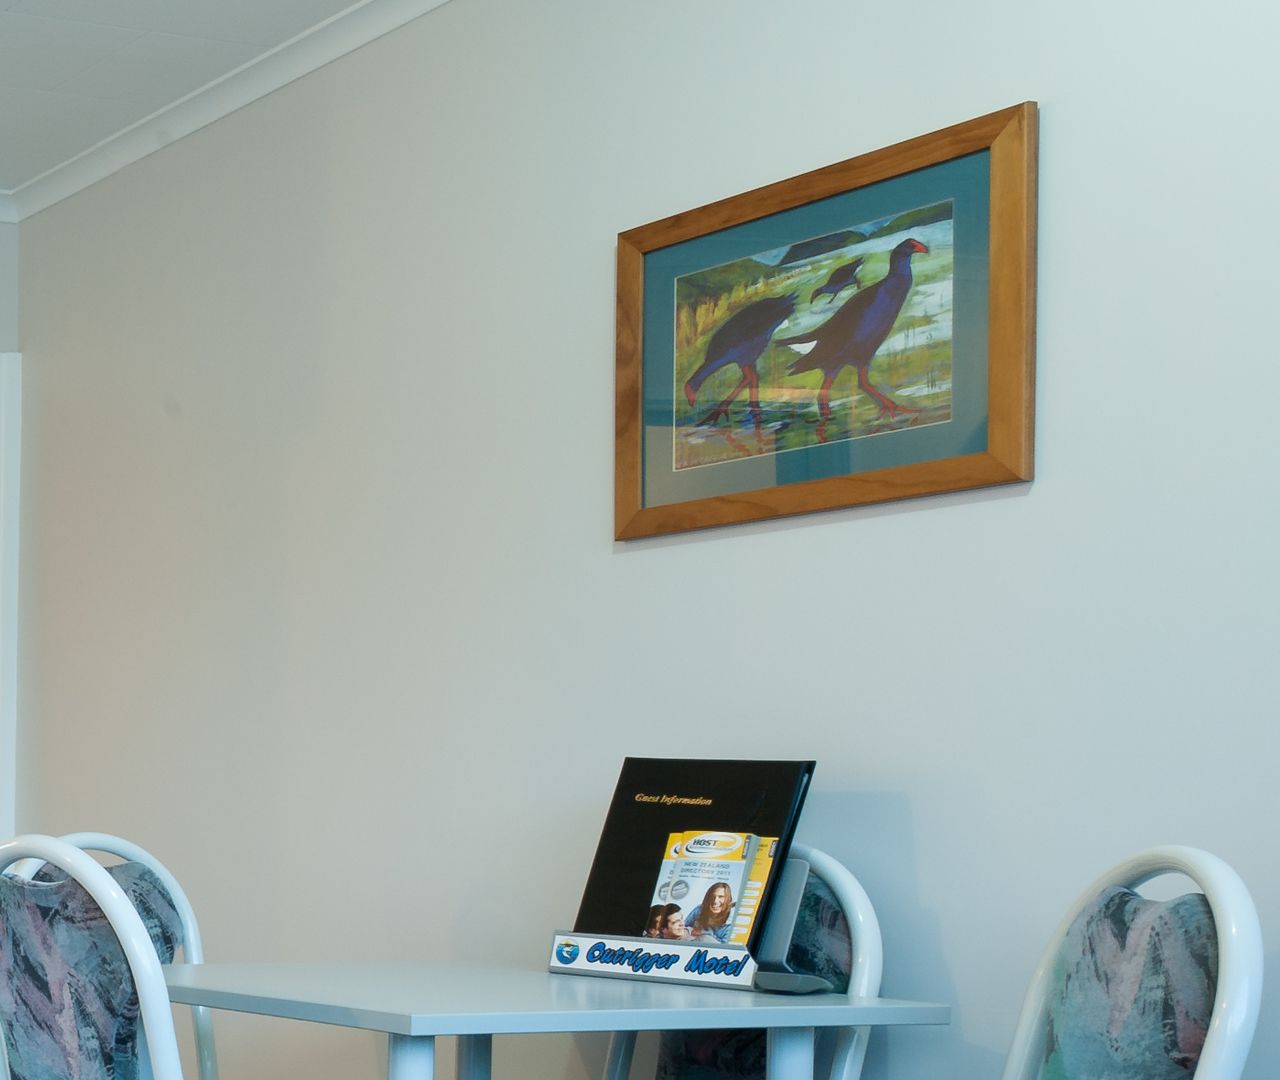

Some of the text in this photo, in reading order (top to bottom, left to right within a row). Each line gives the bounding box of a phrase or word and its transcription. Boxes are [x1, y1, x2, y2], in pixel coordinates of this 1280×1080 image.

[635, 793, 712, 806] Guest Information
[692, 839, 718, 847] HOST
[586, 941, 750, 977] Outrigger Motel
